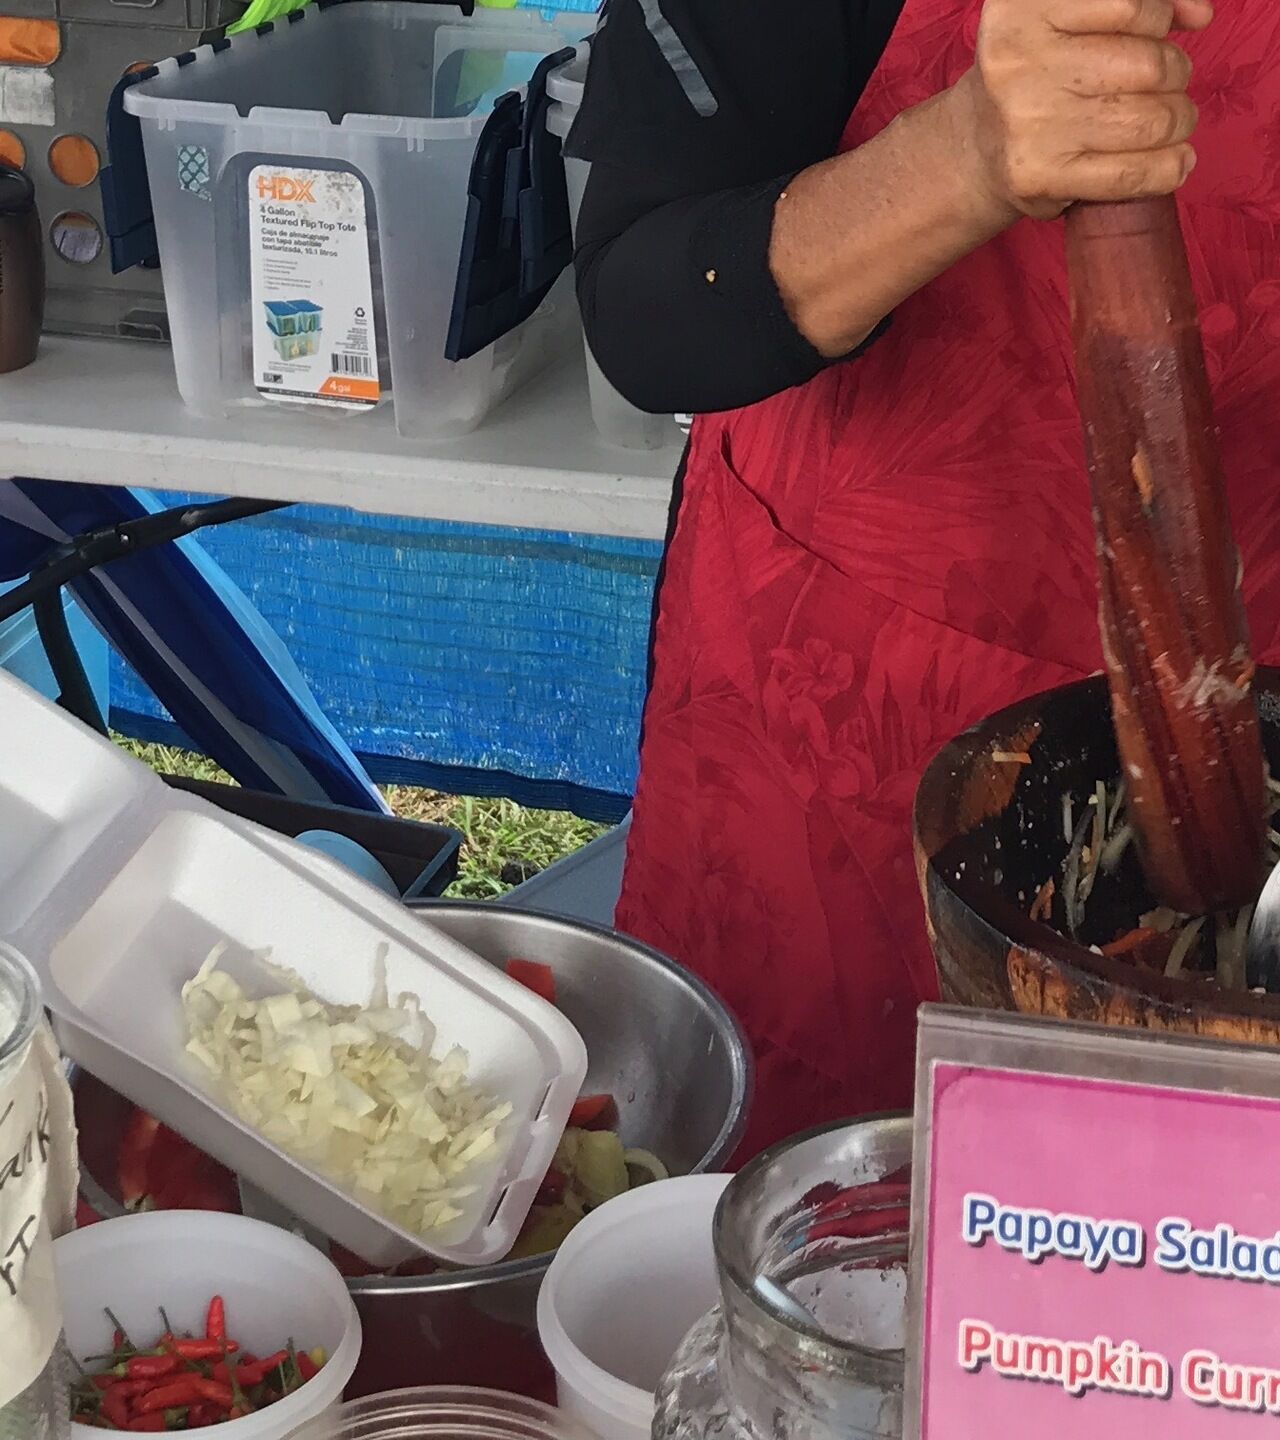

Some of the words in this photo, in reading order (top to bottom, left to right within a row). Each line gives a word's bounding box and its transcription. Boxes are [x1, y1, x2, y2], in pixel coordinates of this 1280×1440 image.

[256, 175, 317, 203] HDX
[267, 206, 296, 217] Gallon
[261, 215, 298, 227] Textured
[300, 219, 317, 229] Flip
[318, 221, 336, 231] Top
[336, 222, 357, 232] Tote
[329, 380, 337, 391] 4
[962, 1193, 1144, 1271] Papaya
[959, 1318, 1171, 1397] Pumpkin
